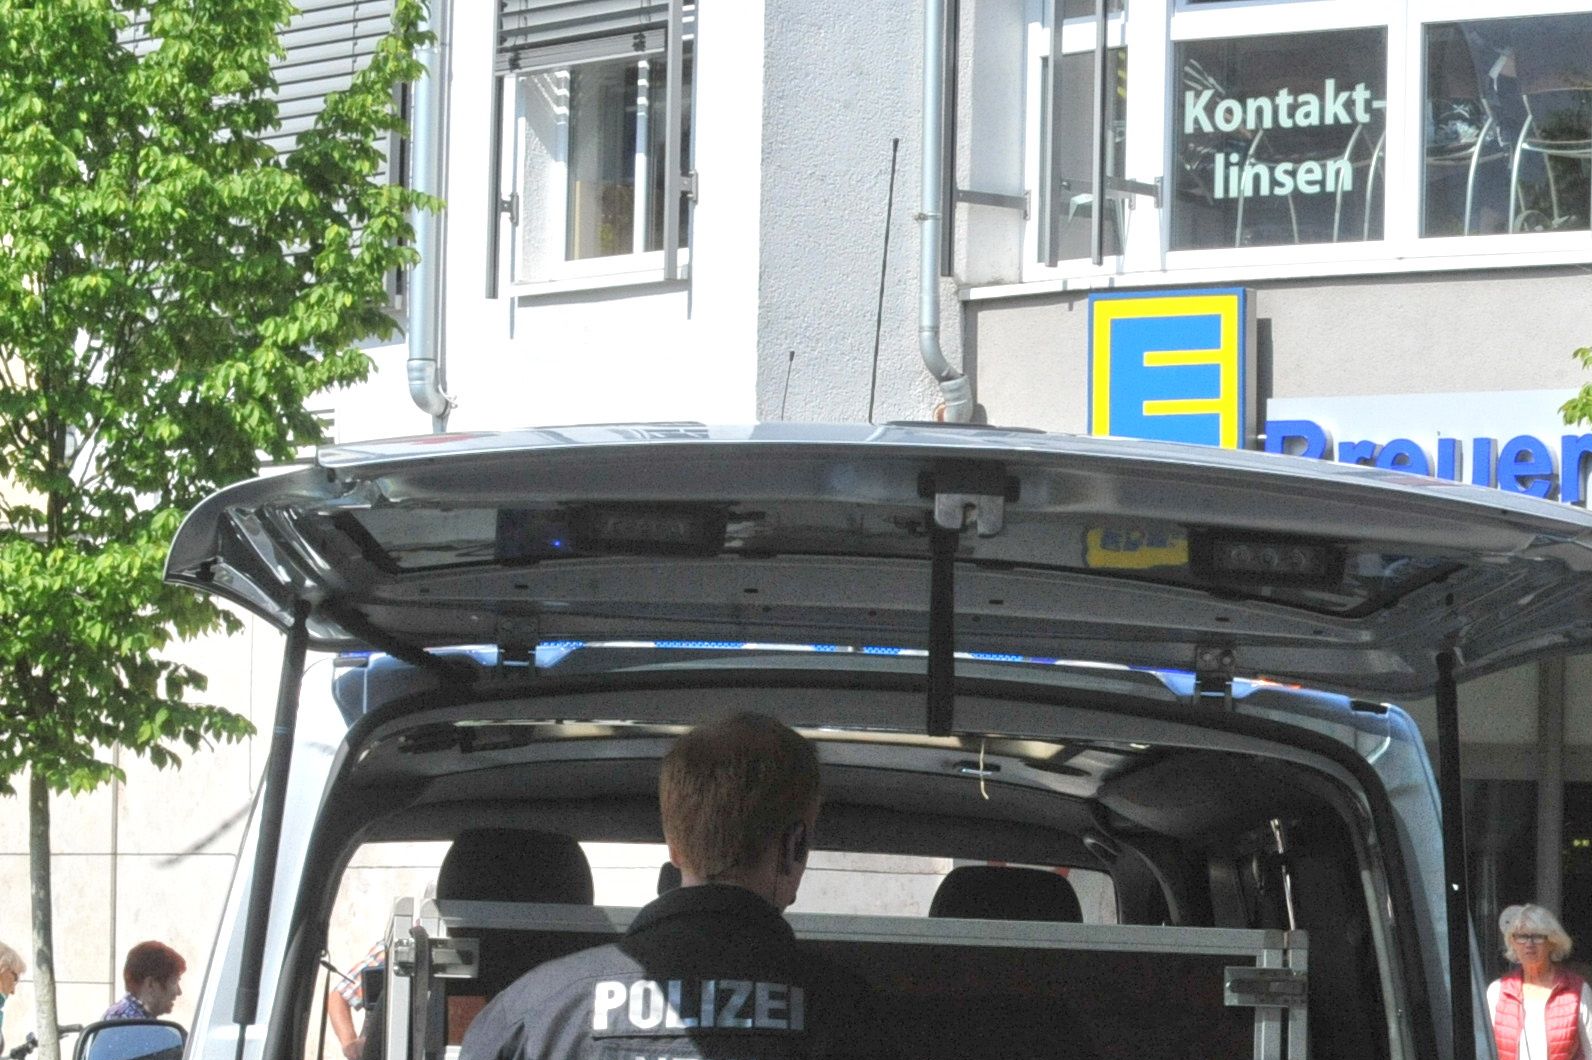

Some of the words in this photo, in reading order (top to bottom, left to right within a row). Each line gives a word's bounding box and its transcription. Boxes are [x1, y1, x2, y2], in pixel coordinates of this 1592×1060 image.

[1184, 78, 1387, 134] Kontakt-
[1214, 152, 1354, 199] linsen
[592, 979, 805, 1031] POLIZEI
